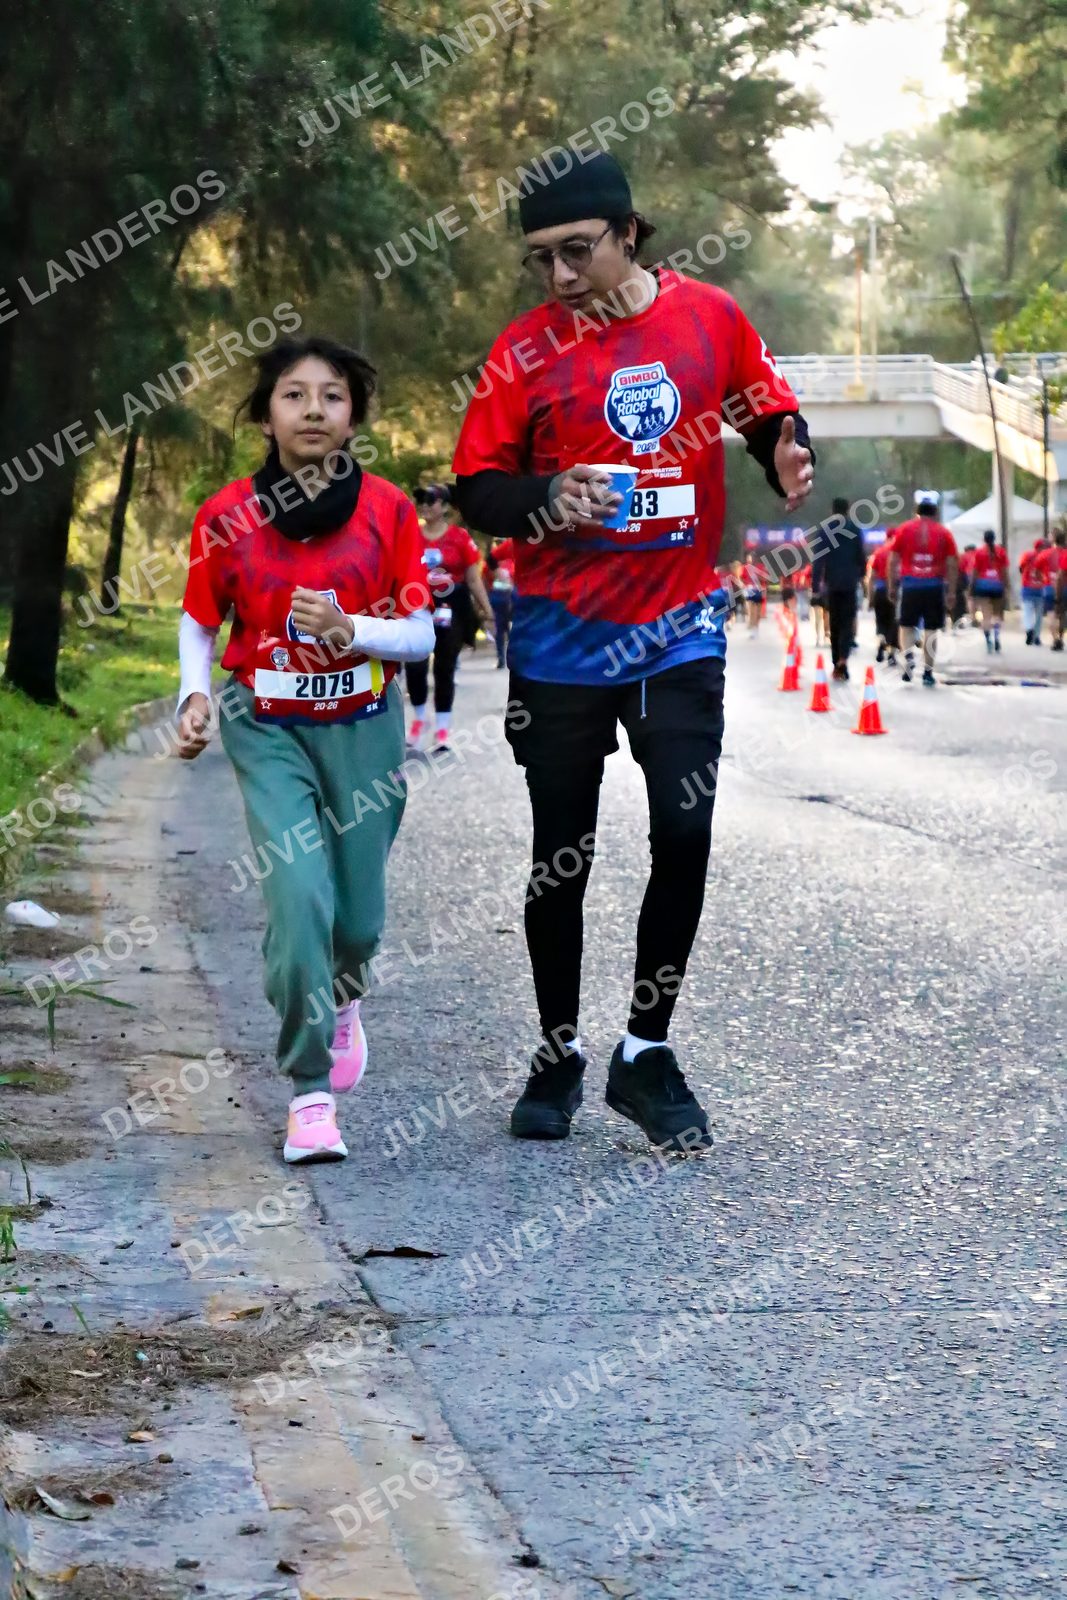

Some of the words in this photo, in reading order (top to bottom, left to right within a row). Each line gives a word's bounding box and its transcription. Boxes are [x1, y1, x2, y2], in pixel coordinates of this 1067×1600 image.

[619, 371, 659, 386] BIMBO
[622, 385, 660, 403] Global
[617, 400, 648, 417] Race
[635, 441, 658, 454] 2026
[670, 532, 684, 541] 5K
[295, 670, 355, 698] 2079
[313, 701, 338, 711] 20-26
[366, 702, 379, 713] 5K
